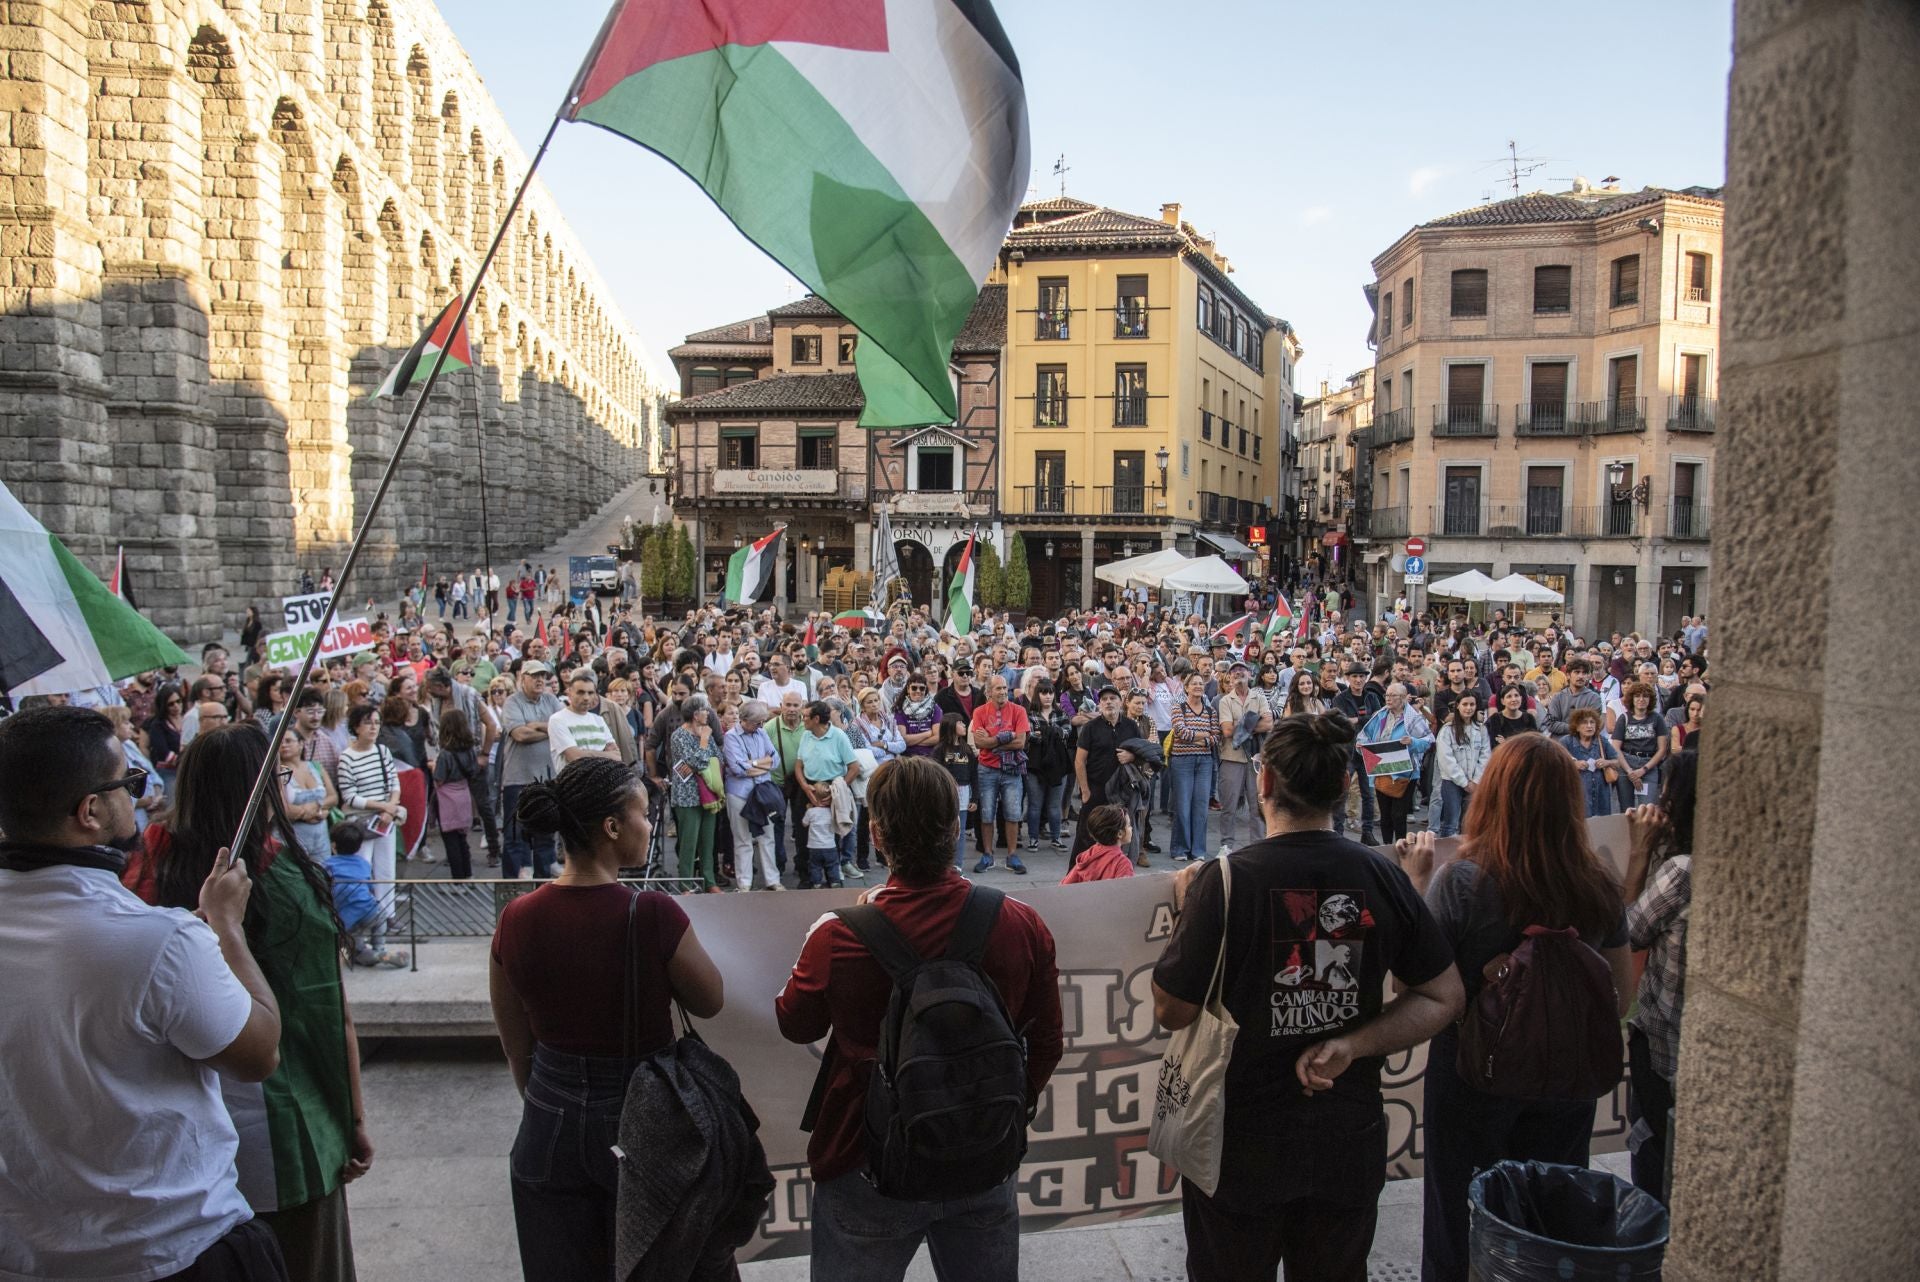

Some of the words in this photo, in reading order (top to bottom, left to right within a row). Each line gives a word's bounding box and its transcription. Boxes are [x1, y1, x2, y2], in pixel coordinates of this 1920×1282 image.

[891, 529, 933, 547] ORNO
[933, 546, 943, 554] DE
[1270, 989, 1339, 1007] CAMBIAR
[1341, 991, 1359, 1006] EL
[1271, 1002, 1359, 1029] MUNDO
[1270, 1028, 1282, 1037] DE
